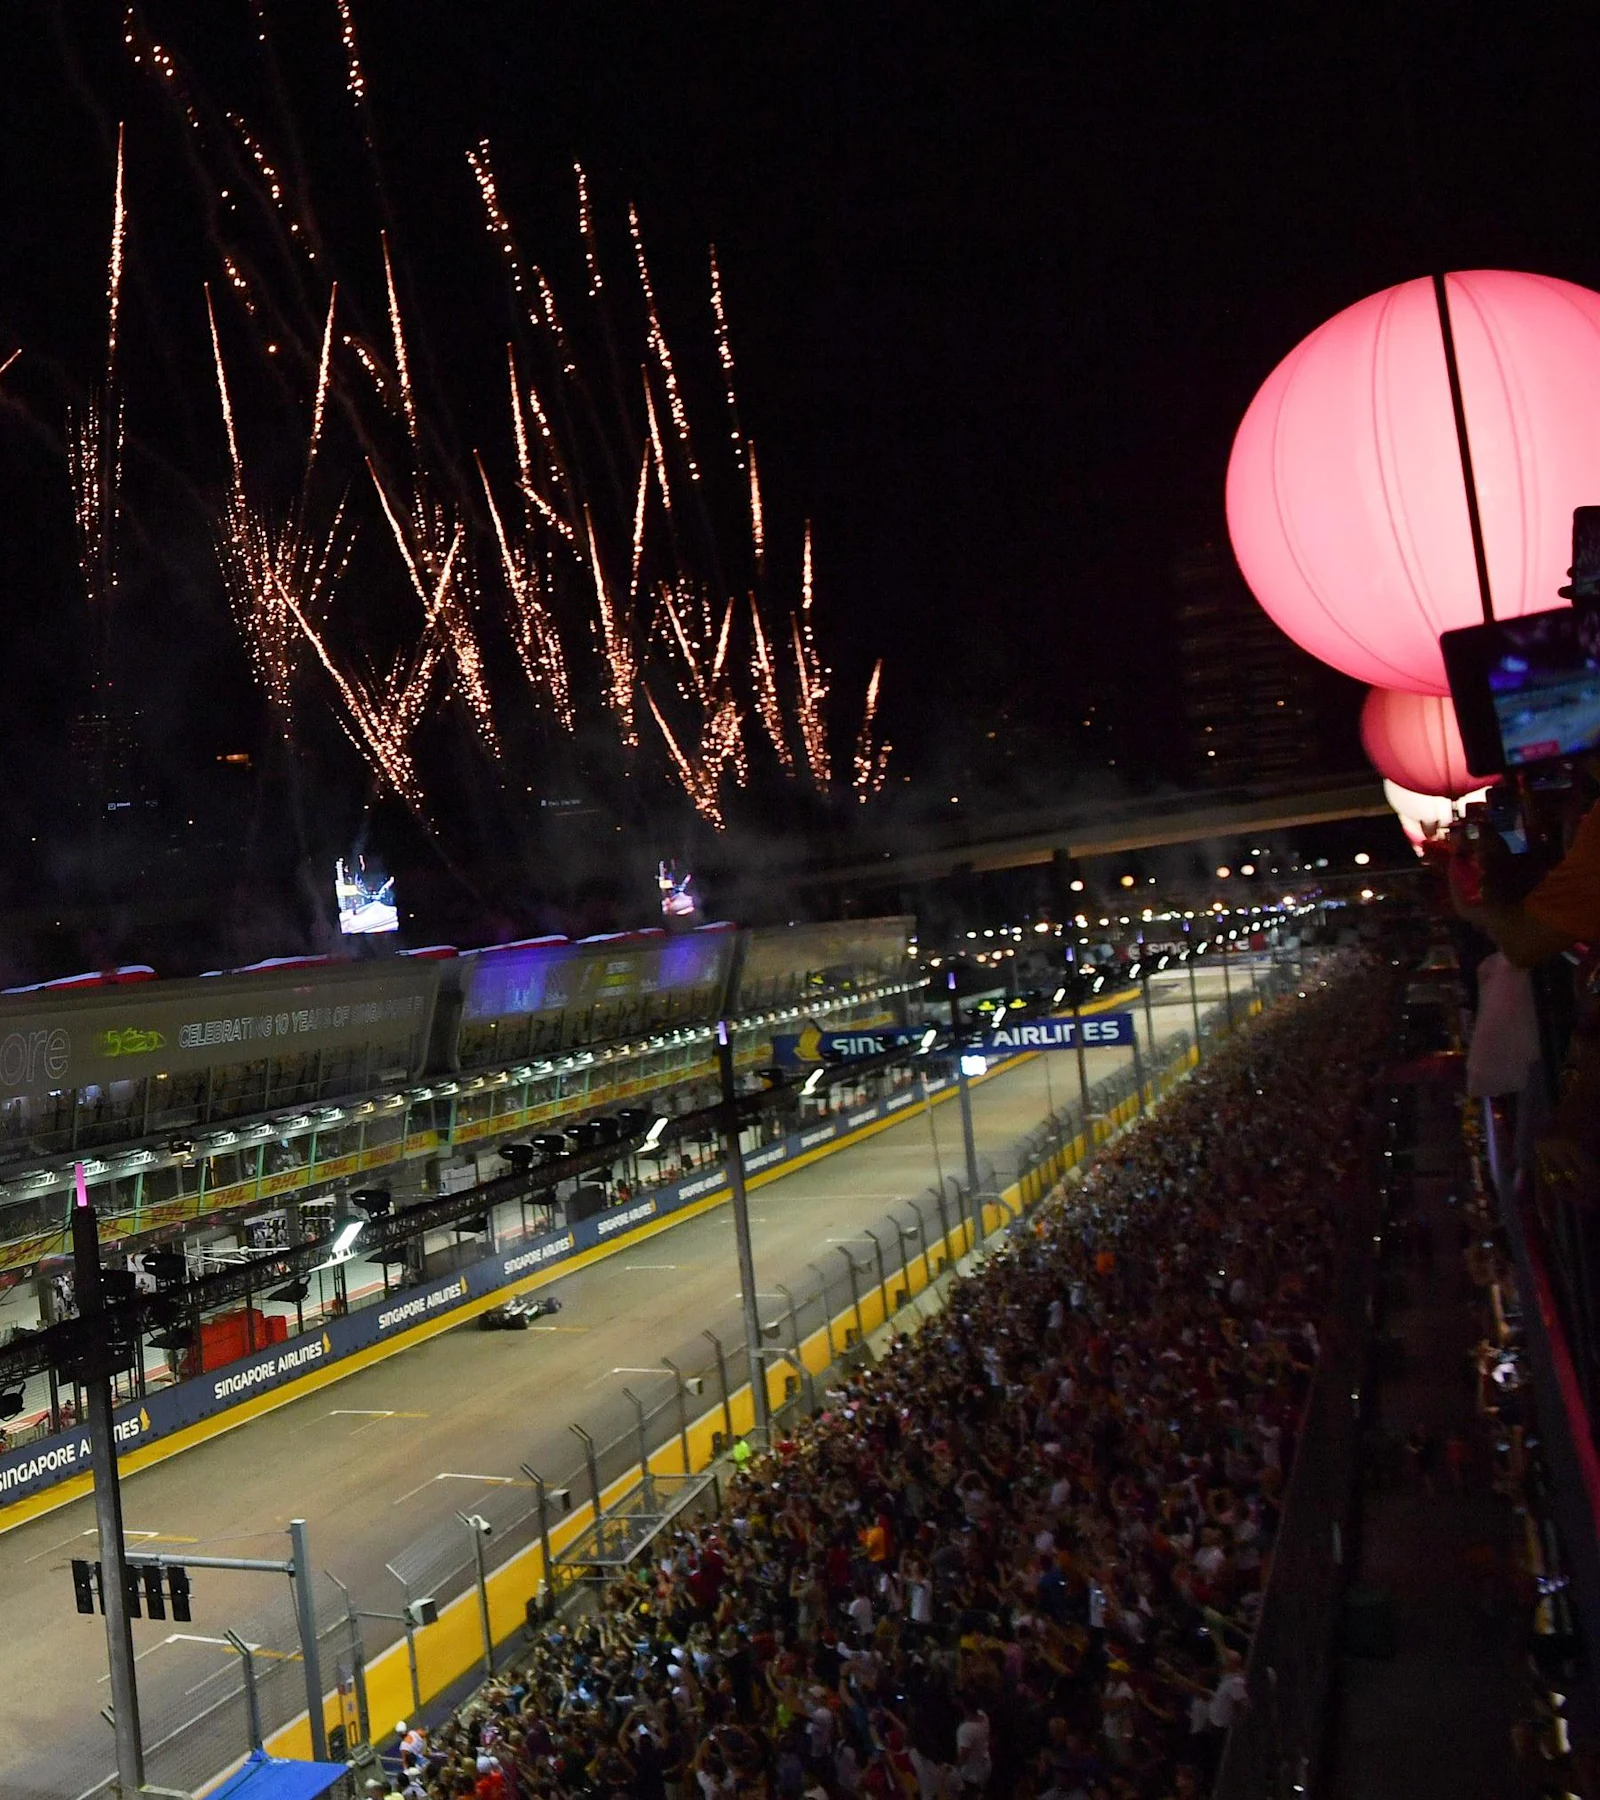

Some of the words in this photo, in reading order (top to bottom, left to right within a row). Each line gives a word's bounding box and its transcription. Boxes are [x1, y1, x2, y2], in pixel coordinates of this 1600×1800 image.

[504, 1248, 542, 1275] SINGAPORE
[378, 1297, 426, 1330] SINGAPORE
[426, 1283, 461, 1310] AIRLINES
[214, 1363, 276, 1400] SINGAPORE
[278, 1343, 324, 1373] AIRLINES
